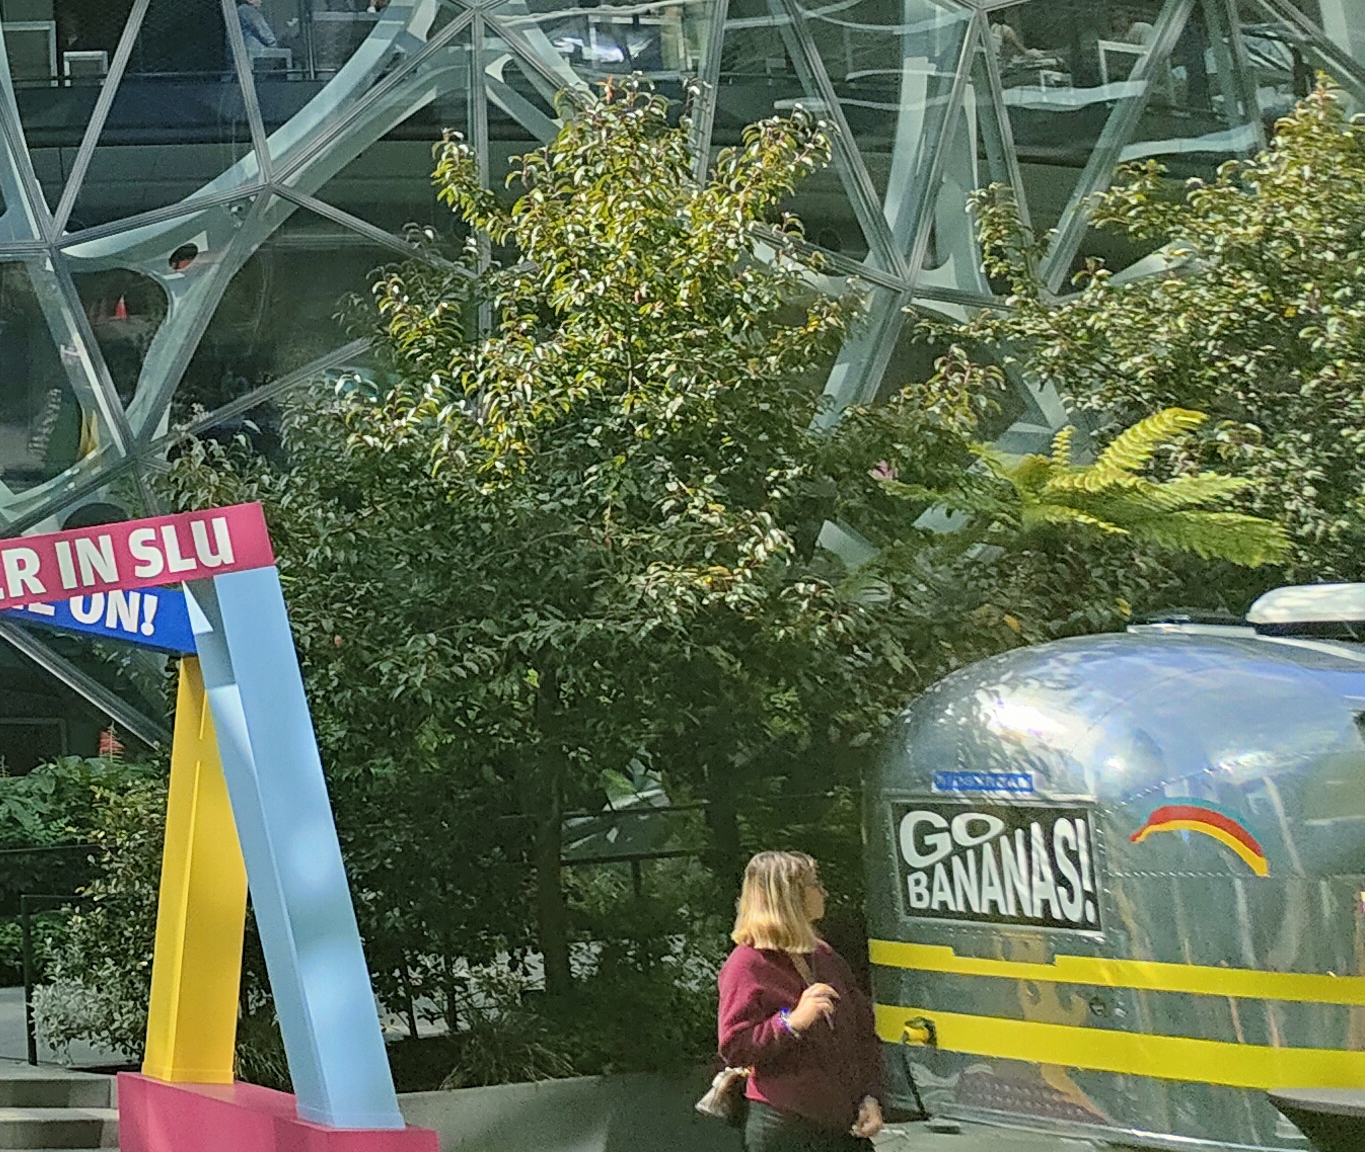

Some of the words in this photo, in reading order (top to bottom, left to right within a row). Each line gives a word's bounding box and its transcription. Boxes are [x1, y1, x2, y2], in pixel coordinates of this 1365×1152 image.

[54, 535, 118, 589] IN
[129, 517, 235, 579] SLU
[69, 590, 158, 636] ON!
[899, 810, 1004, 868] GO
[907, 817, 1097, 924] BANANAS!
